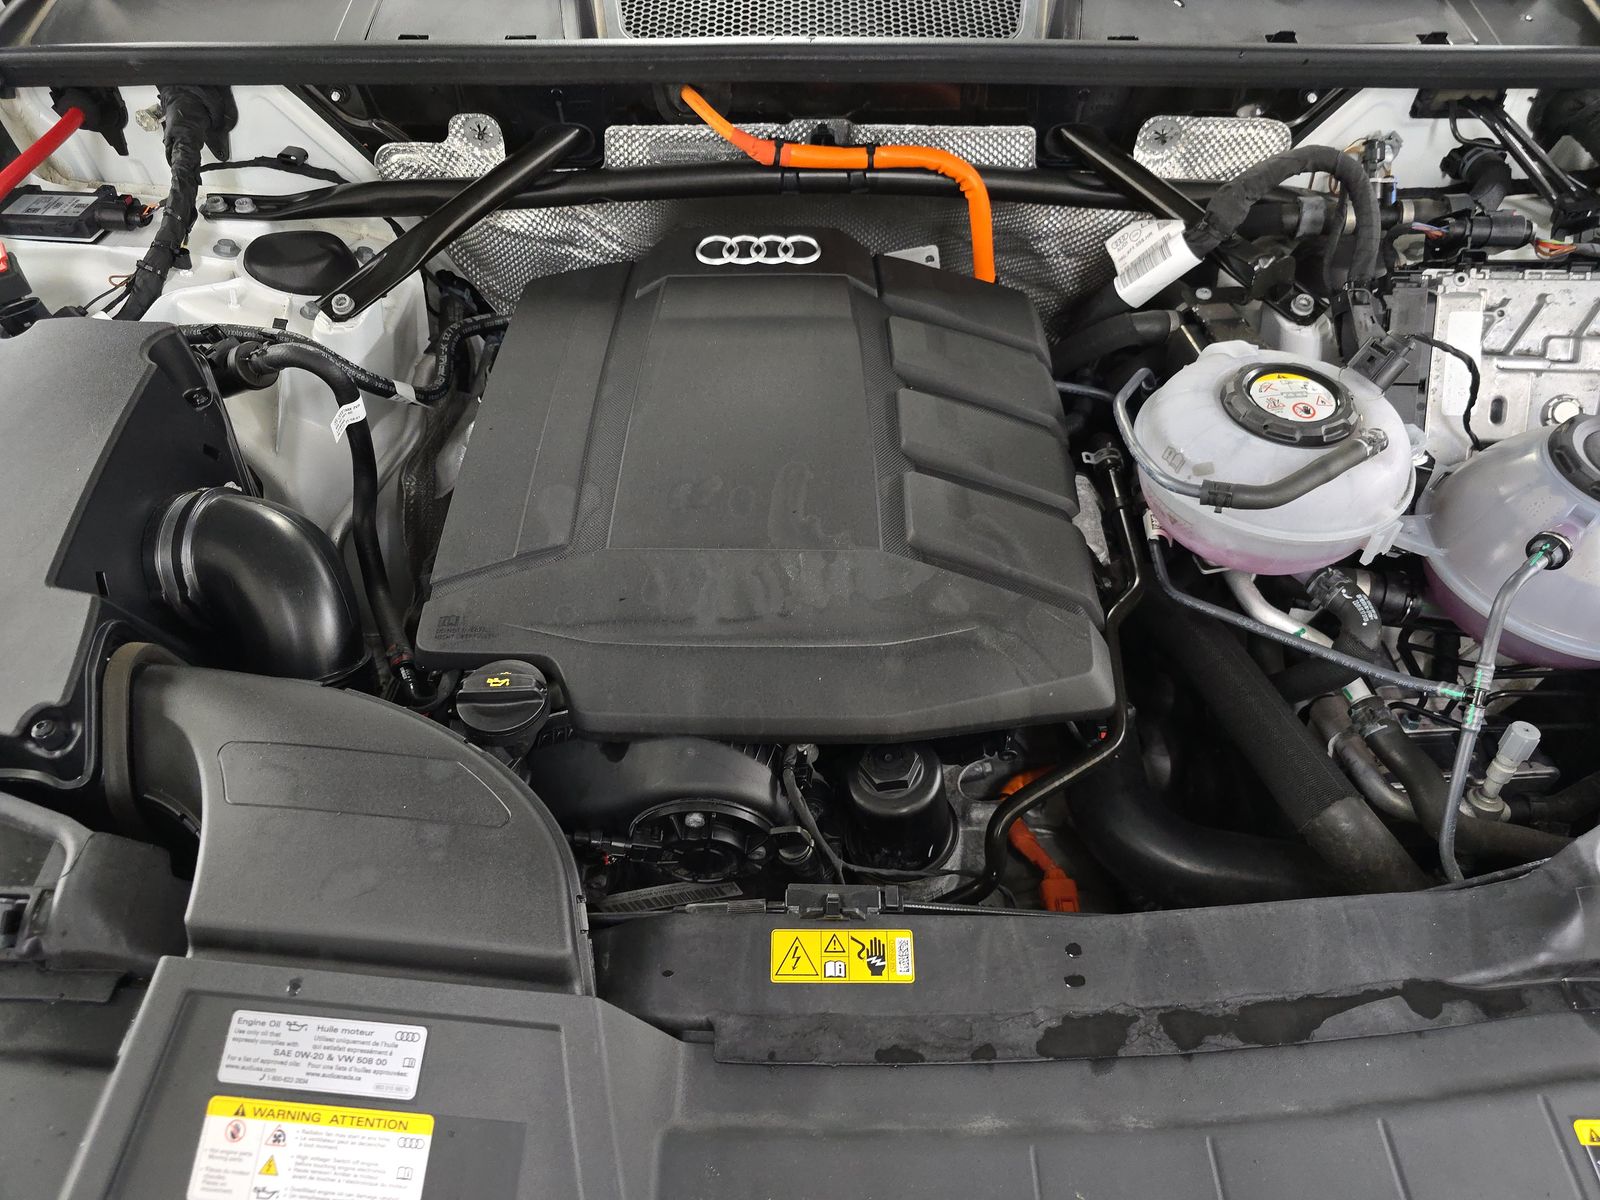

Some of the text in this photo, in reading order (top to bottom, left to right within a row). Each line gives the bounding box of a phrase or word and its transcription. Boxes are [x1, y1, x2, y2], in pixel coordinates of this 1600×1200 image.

[237, 1017, 281, 1028] Engine Oil
[317, 1025, 374, 1036] Huile moteur
[273, 1048, 292, 1057] SAE
[294, 1051, 324, 1060] 0W-20
[337, 1055, 354, 1063] VW
[356, 1056, 373, 1064] 508
[376, 1058, 388, 1066] 00
[252, 1106, 409, 1131] WARNING ATTENTION
